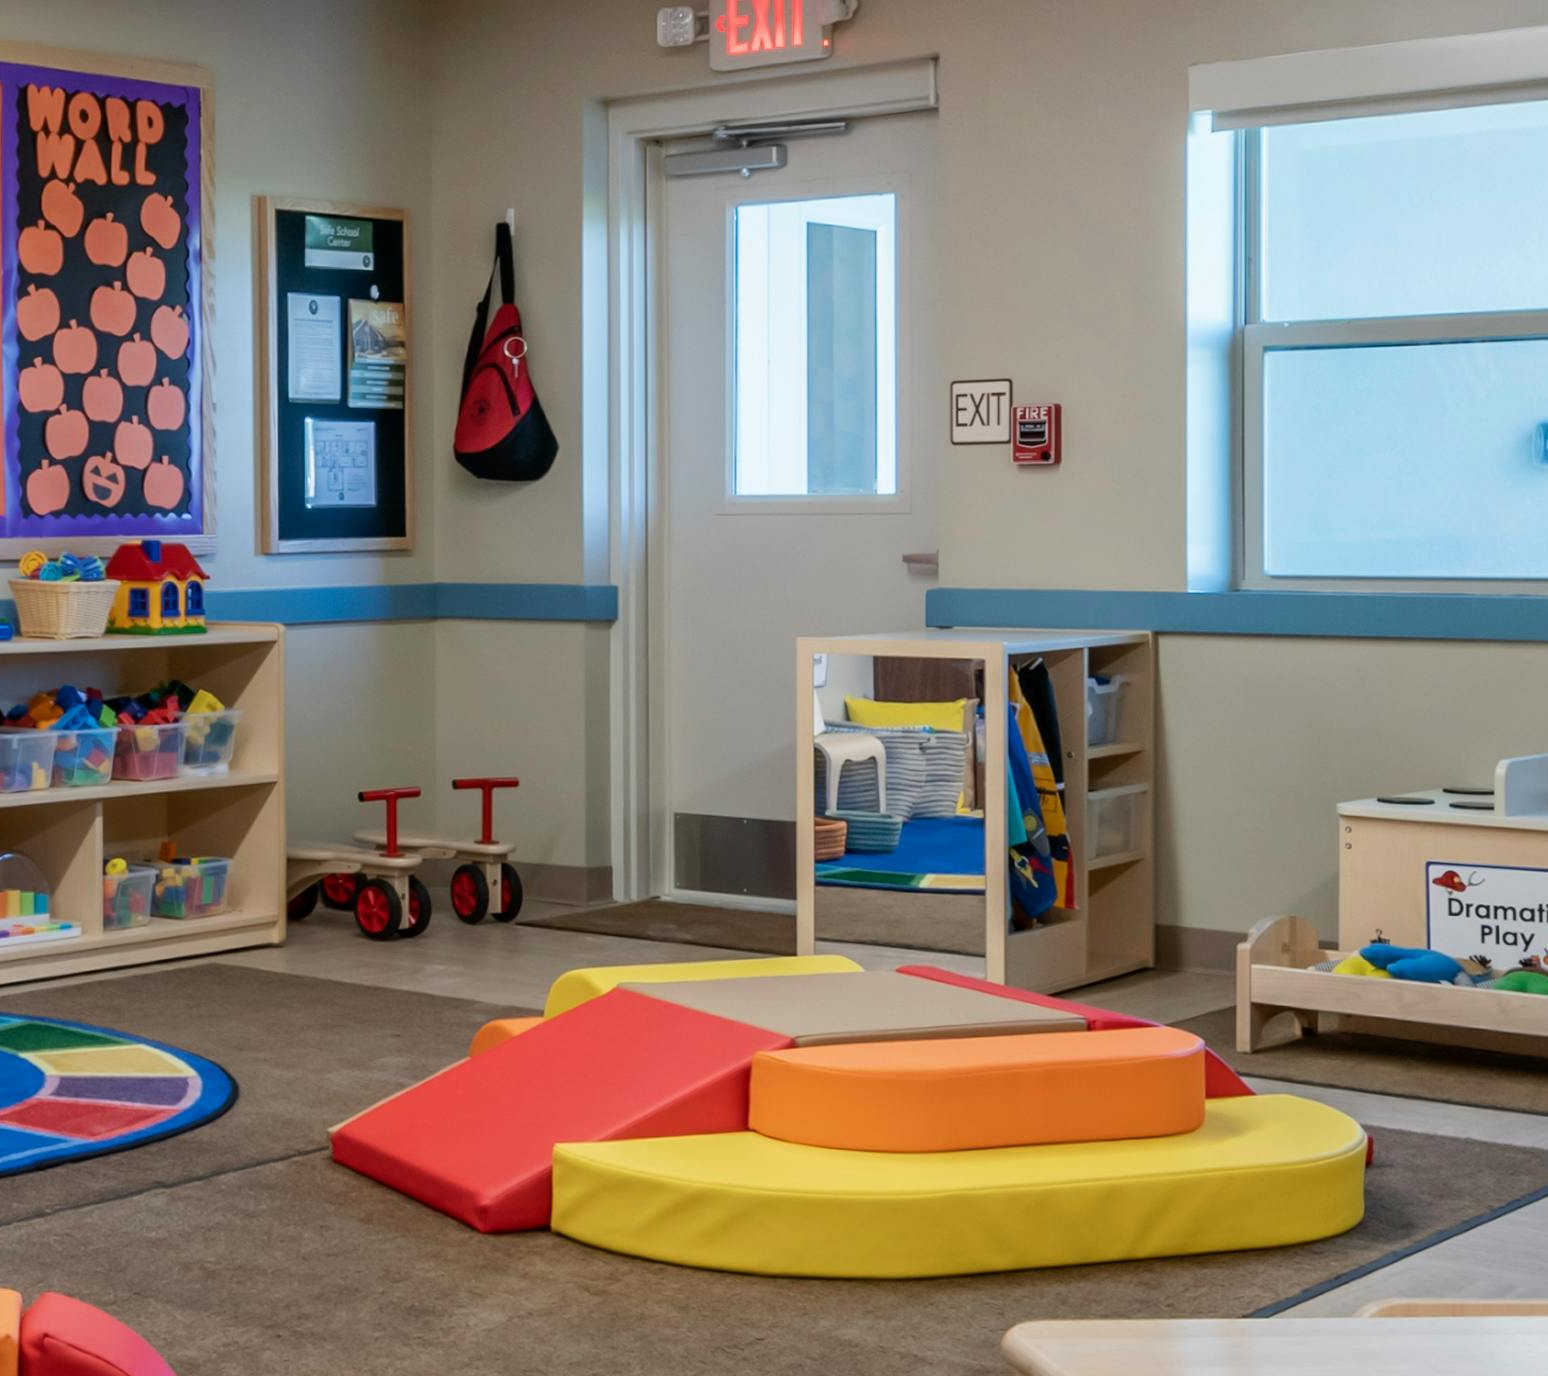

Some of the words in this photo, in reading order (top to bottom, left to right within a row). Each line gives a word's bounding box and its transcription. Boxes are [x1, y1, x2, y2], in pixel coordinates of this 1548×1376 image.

[26, 83, 164, 145] WORD
[37, 130, 157, 186] WALL
[328, 236, 351, 247] Center
[336, 226, 360, 237] School
[955, 392, 1006, 427] EXIT
[1016, 407, 1049, 420] FIRE
[1480, 925, 1535, 952] Play
